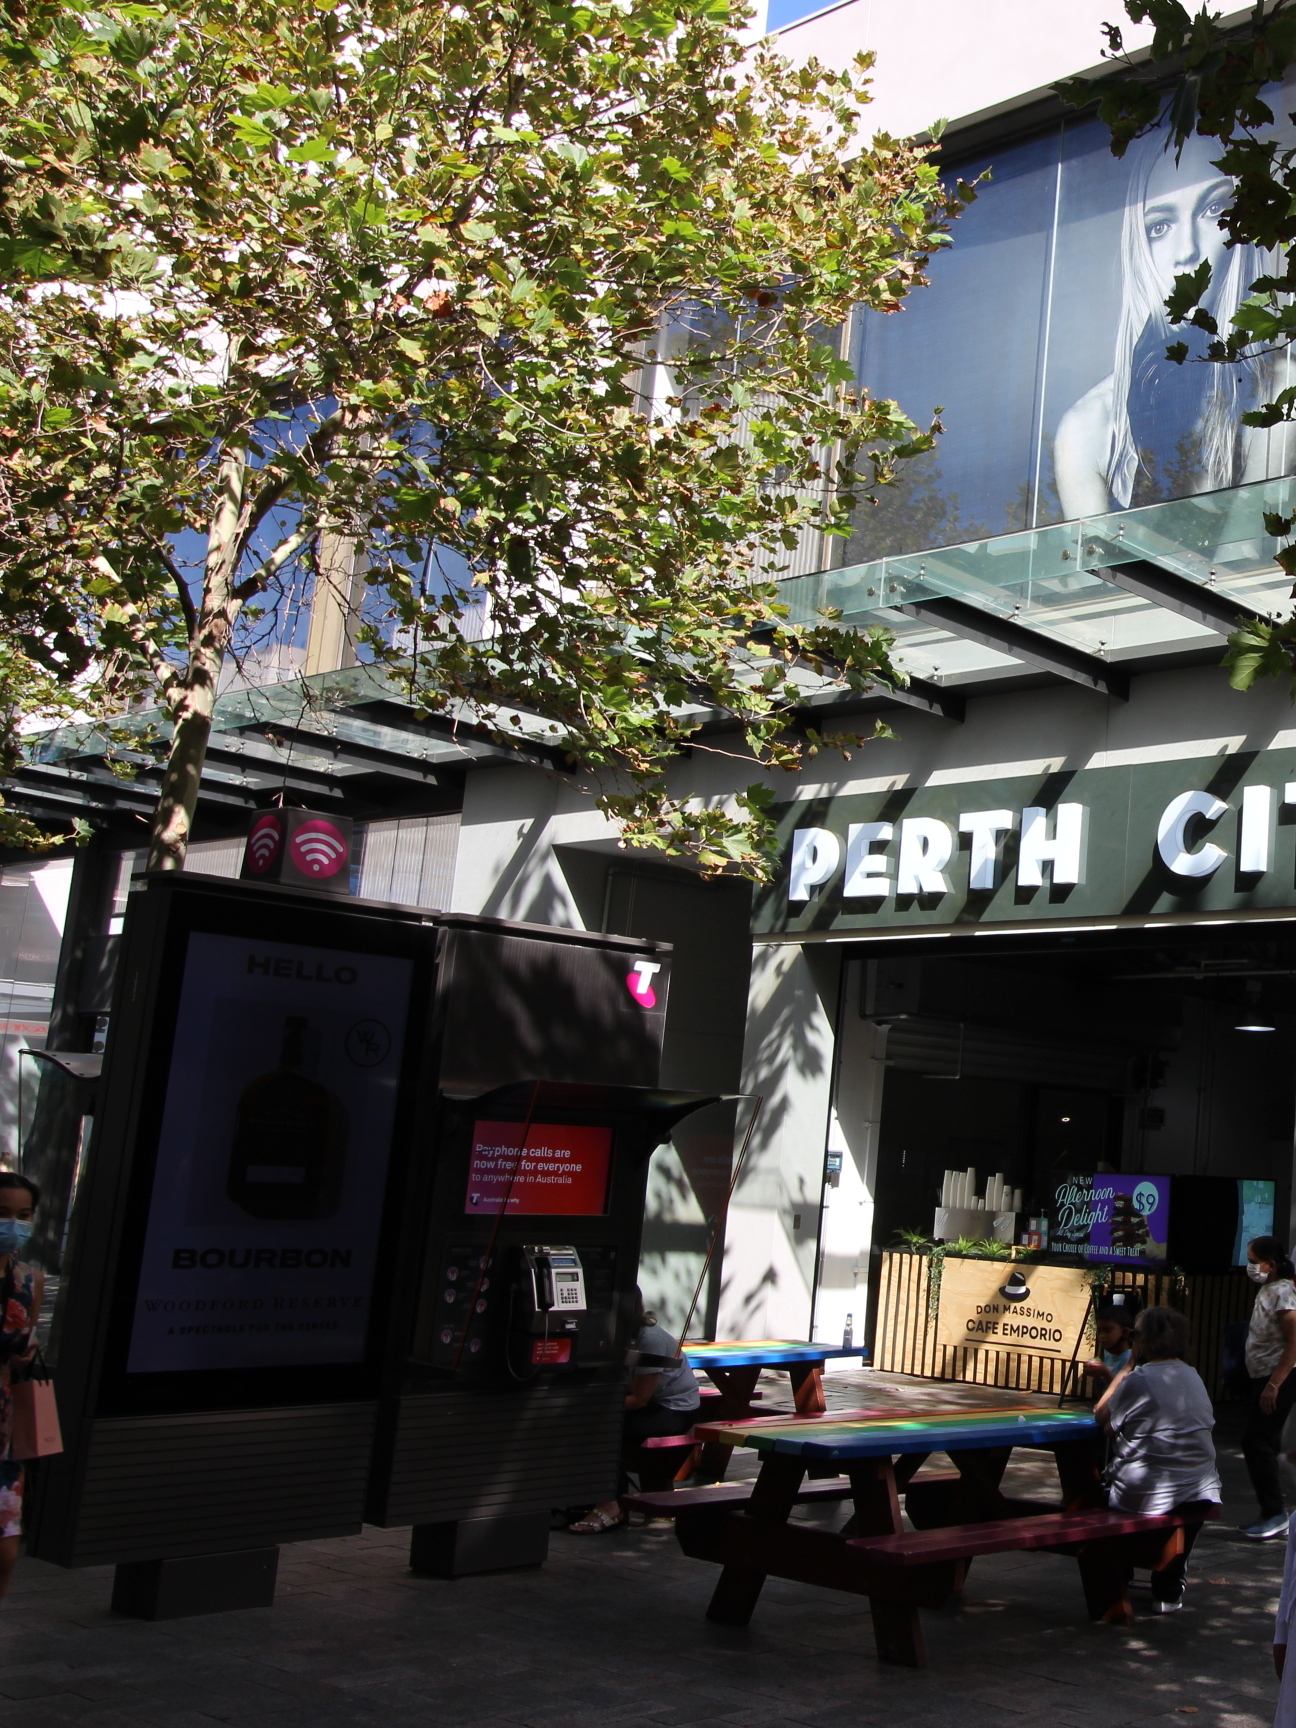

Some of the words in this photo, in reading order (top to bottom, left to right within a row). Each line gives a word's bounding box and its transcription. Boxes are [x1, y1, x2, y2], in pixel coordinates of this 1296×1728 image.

[788, 802, 1091, 902] PERTH
[246, 954, 358, 985] HELLO
[529, 1146, 553, 1157] calls
[554, 1149, 571, 1158] are
[473, 1159, 495, 1169] now
[521, 1160, 535, 1170] for
[537, 1162, 582, 1174] everyone
[472, 1173, 481, 1182] to
[482, 1173, 525, 1184] anywhere
[526, 1174, 535, 1182] in
[535, 1174, 573, 1184] Australia
[1072, 1176, 1093, 1185] NEW
[1055, 1183, 1116, 1207] Afternoon
[1135, 1191, 1156, 1213] $9
[1058, 1203, 1109, 1233] Delight
[171, 1248, 353, 1270] BOURBON
[144, 1298, 265, 1313] WOODFORD
[273, 1296, 364, 1310] RESERVE
[976, 1304, 999, 1315] DON
[1002, 1304, 1054, 1323] MASSIMO
[167, 1326, 176, 1336] A
[179, 1324, 245, 1335] SPECTACLE
[249, 1323, 270, 1333] FOR
[275, 1322, 295, 1332] THE
[299, 1321, 339, 1332] SENSES
[966, 1319, 999, 1335] CAFE
[1002, 1322, 1063, 1343] EMPORIO
